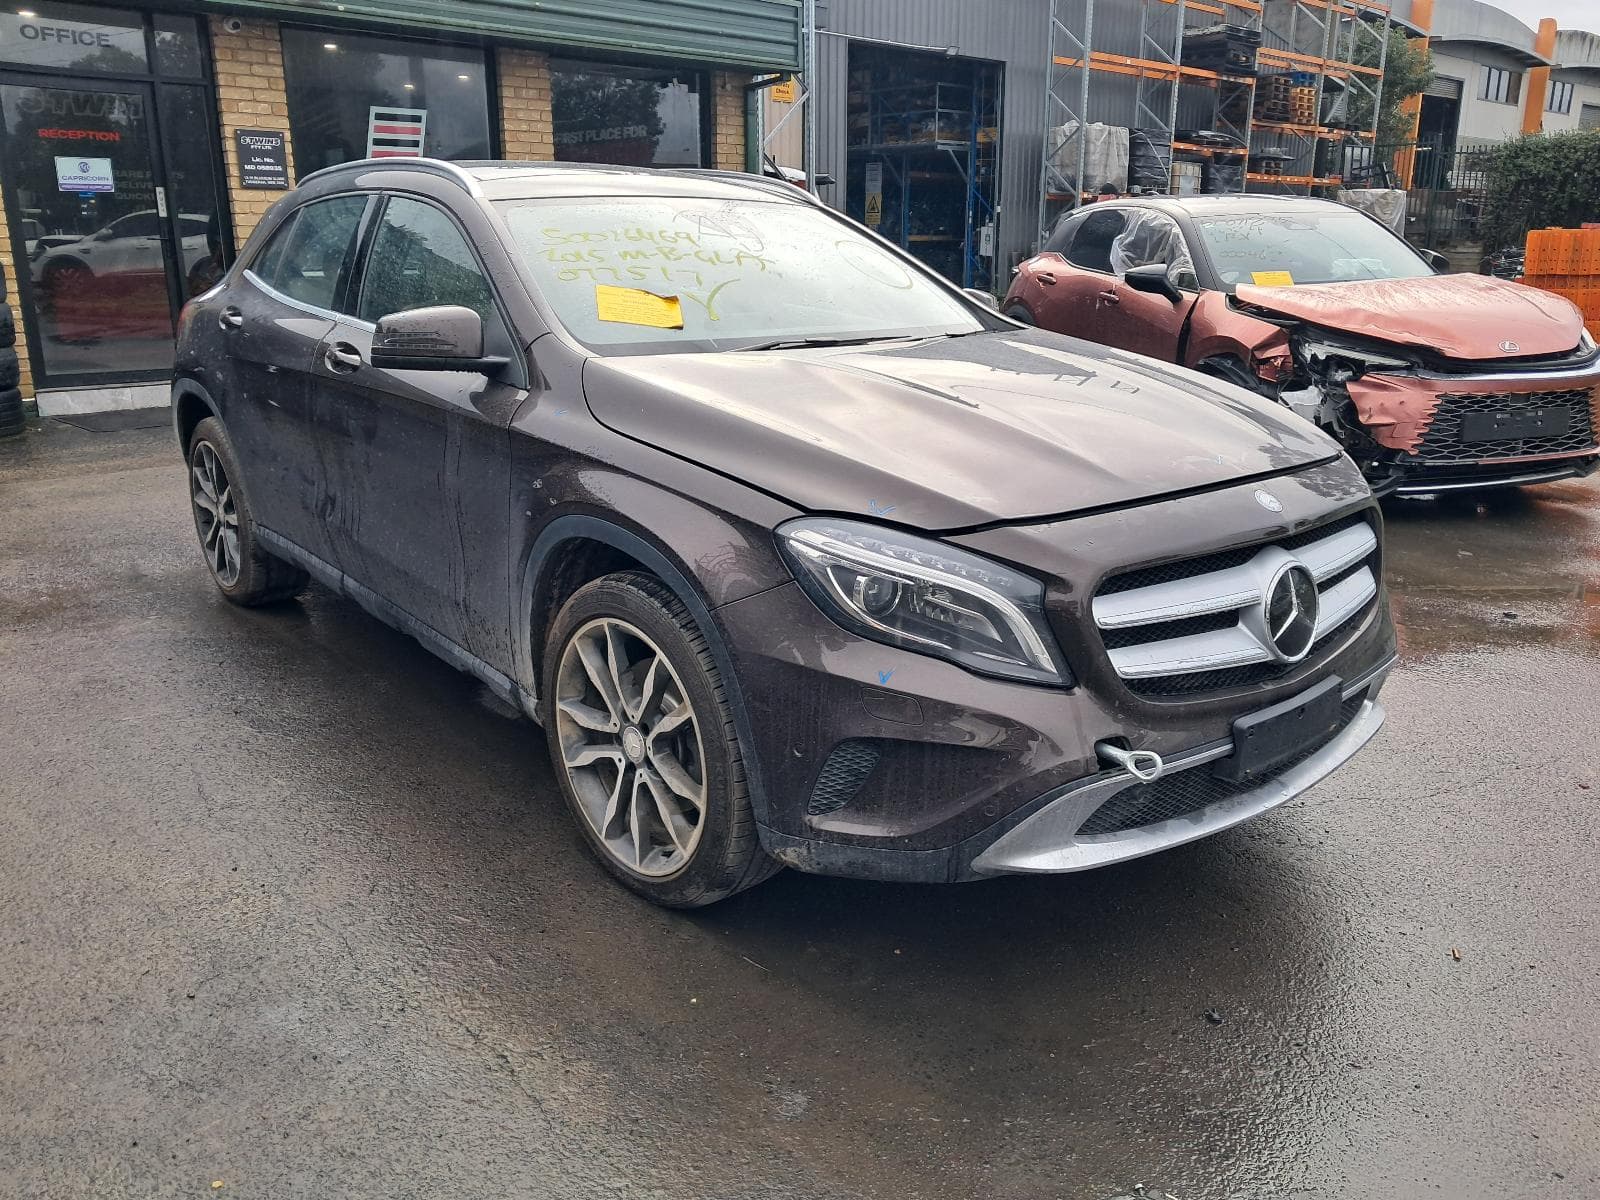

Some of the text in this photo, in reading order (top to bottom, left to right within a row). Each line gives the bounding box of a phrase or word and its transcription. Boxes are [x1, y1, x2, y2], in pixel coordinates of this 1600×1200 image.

[20, 24, 112, 48] OFFICE
[38, 128, 121, 141] RECEPTION
[585, 127, 621, 142] PLACE
[623, 124, 648, 138] FOR
